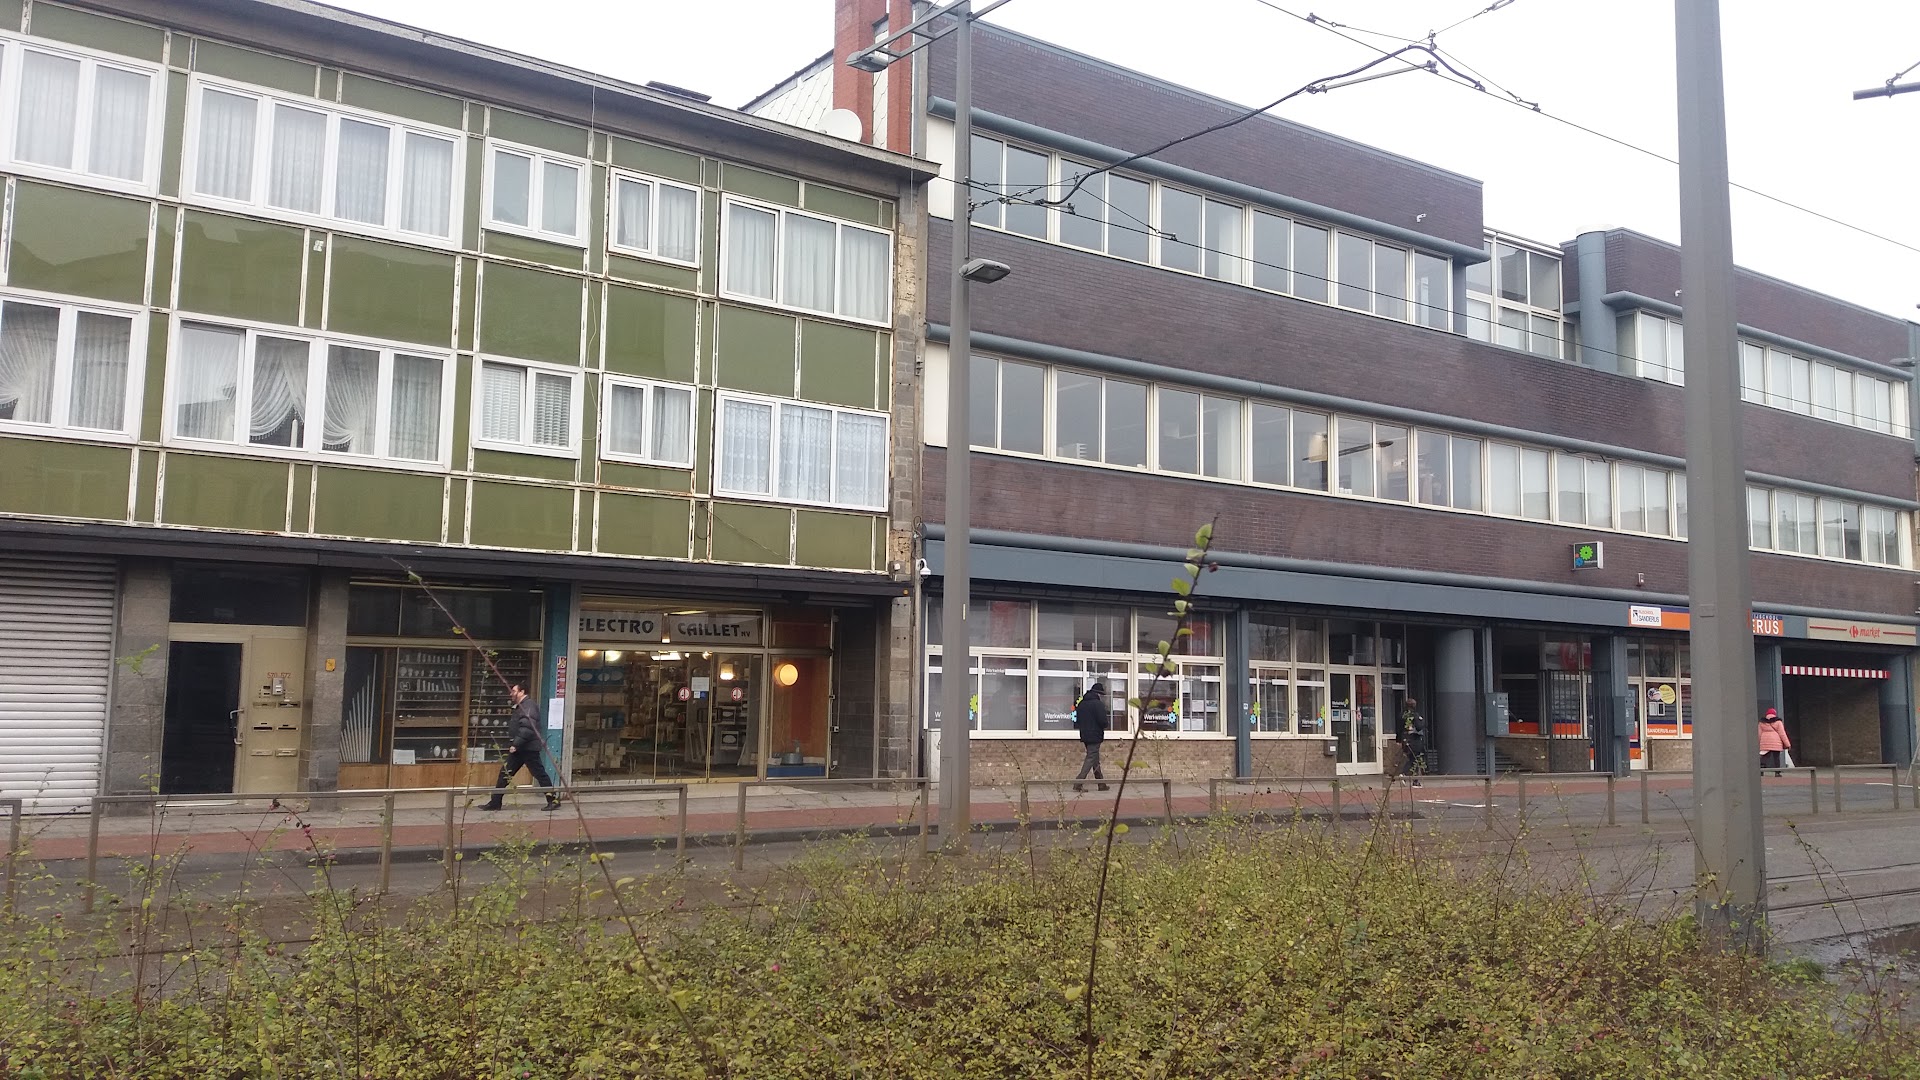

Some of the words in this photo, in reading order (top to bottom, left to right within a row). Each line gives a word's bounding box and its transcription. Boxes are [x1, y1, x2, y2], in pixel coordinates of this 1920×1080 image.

[1638, 615, 1660, 623] SANDERUS
[677, 622, 740, 637] CAILLET
[1860, 627, 1881, 639] market
